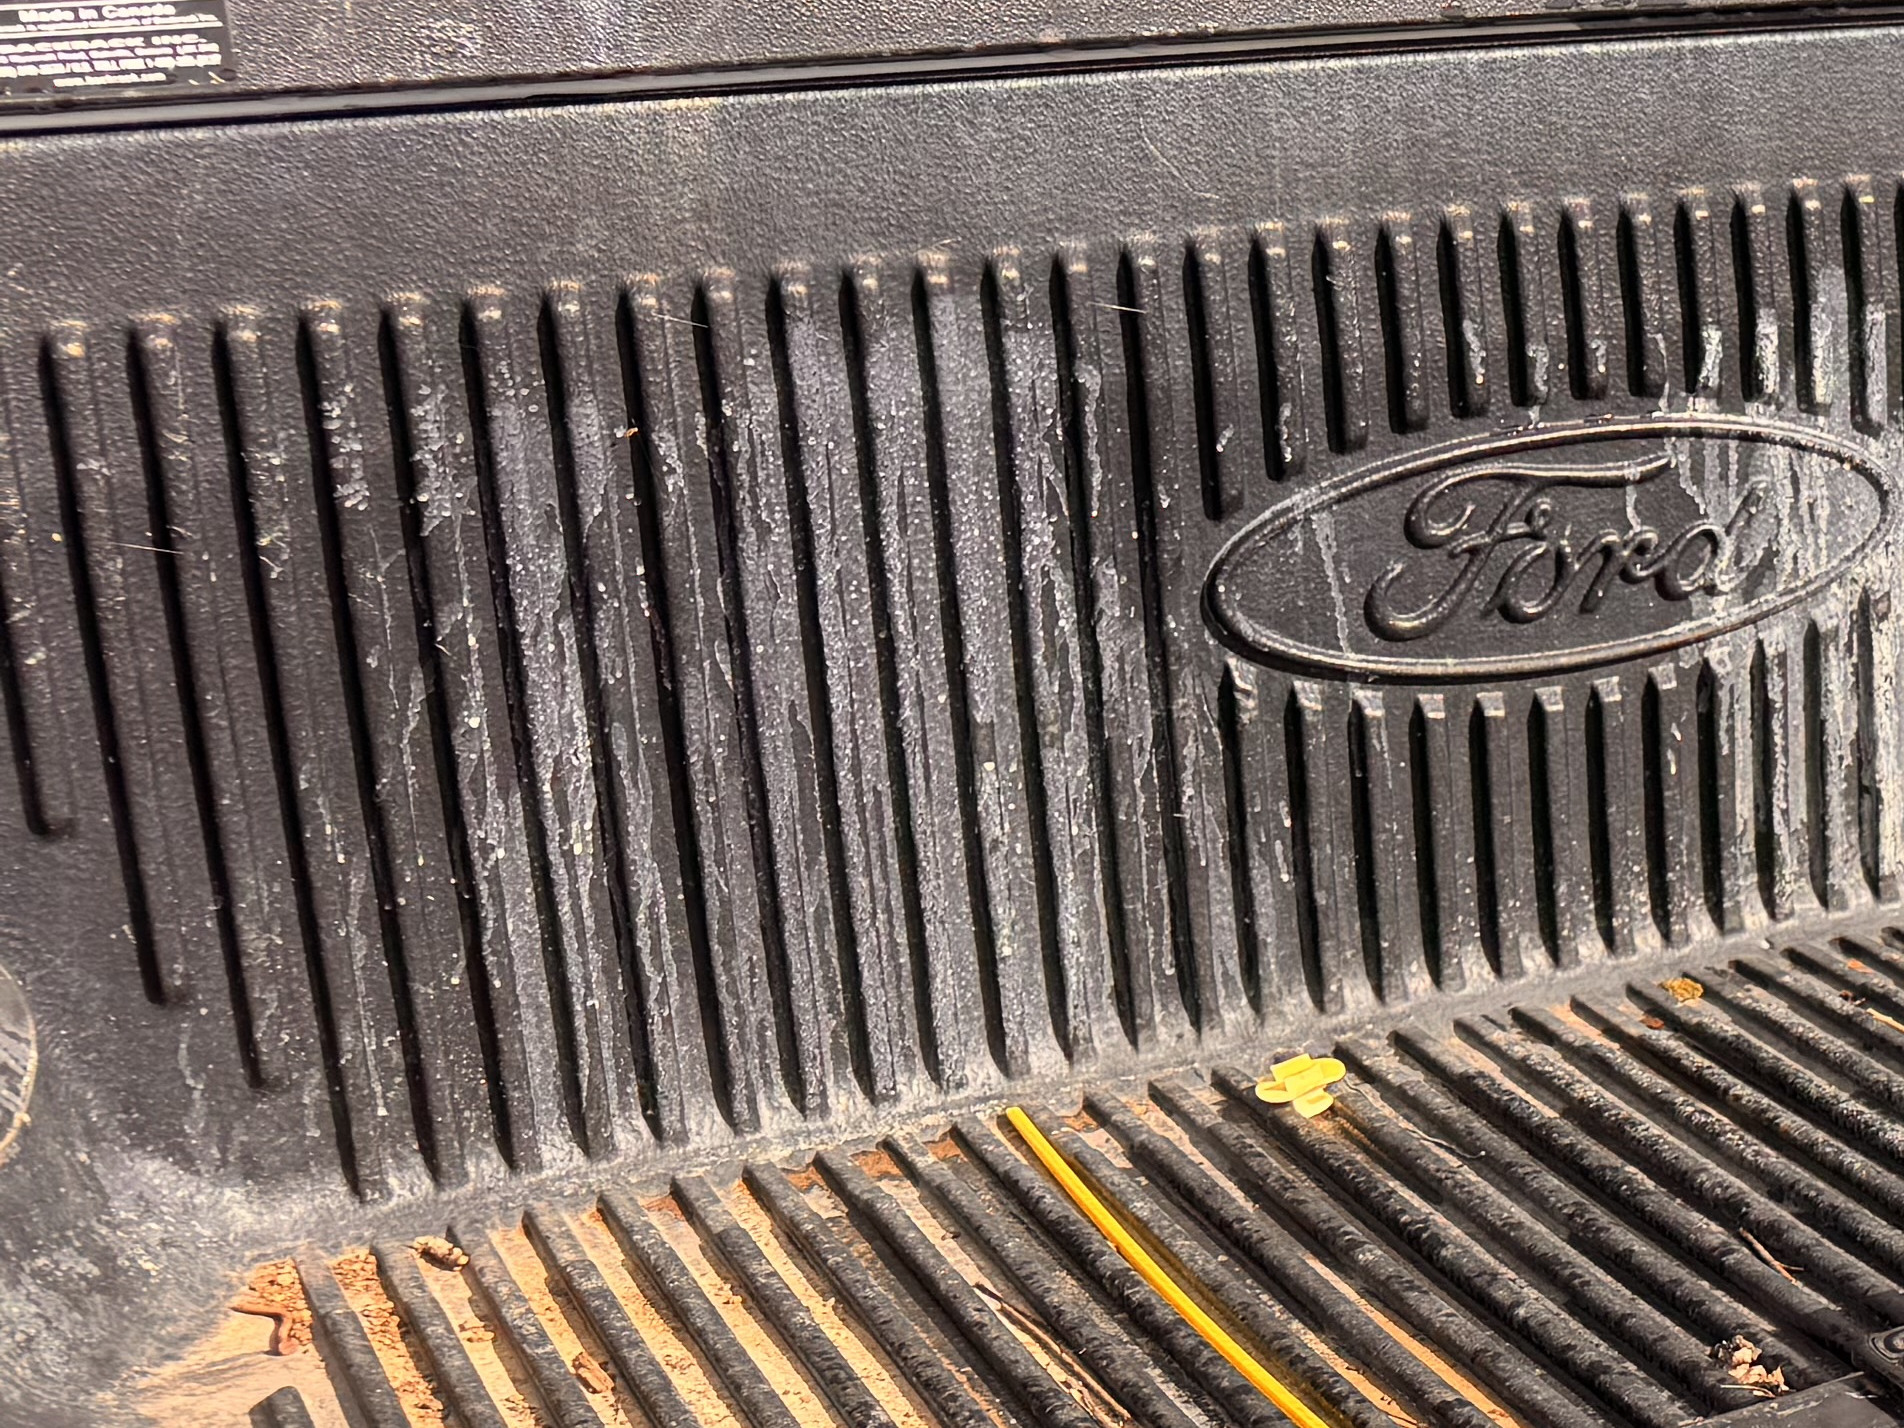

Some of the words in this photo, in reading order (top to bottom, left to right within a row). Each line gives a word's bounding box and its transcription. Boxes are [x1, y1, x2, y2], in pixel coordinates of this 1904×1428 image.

[18, 9, 75, 22] Made
[101, 3, 176, 20] Canada
[1362, 452, 1770, 643] Ford
